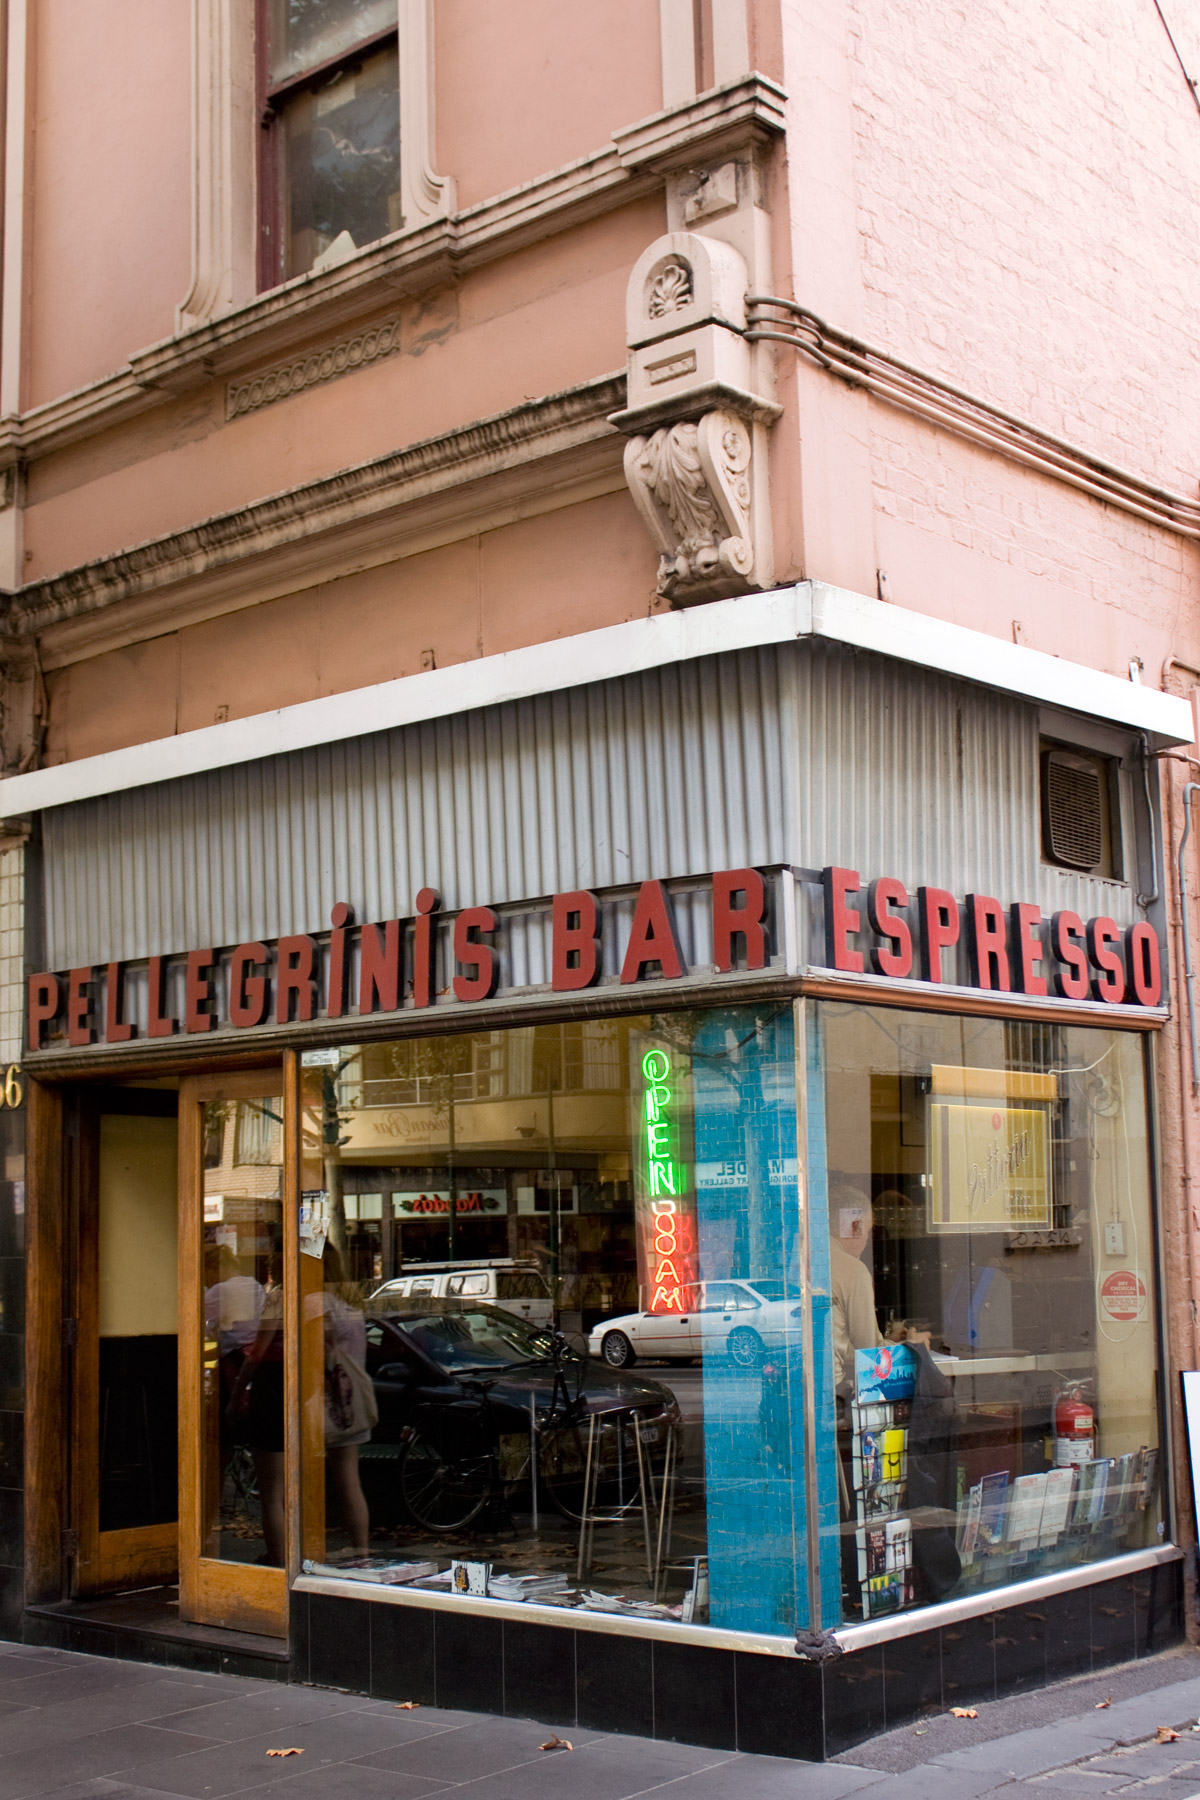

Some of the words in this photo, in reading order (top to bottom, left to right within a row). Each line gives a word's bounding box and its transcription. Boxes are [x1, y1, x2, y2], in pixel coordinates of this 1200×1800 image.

[552, 867, 770, 992] BAR
[823, 866, 1161, 1008] ESPRESSO
[642, 1049, 677, 1197] OPEN
